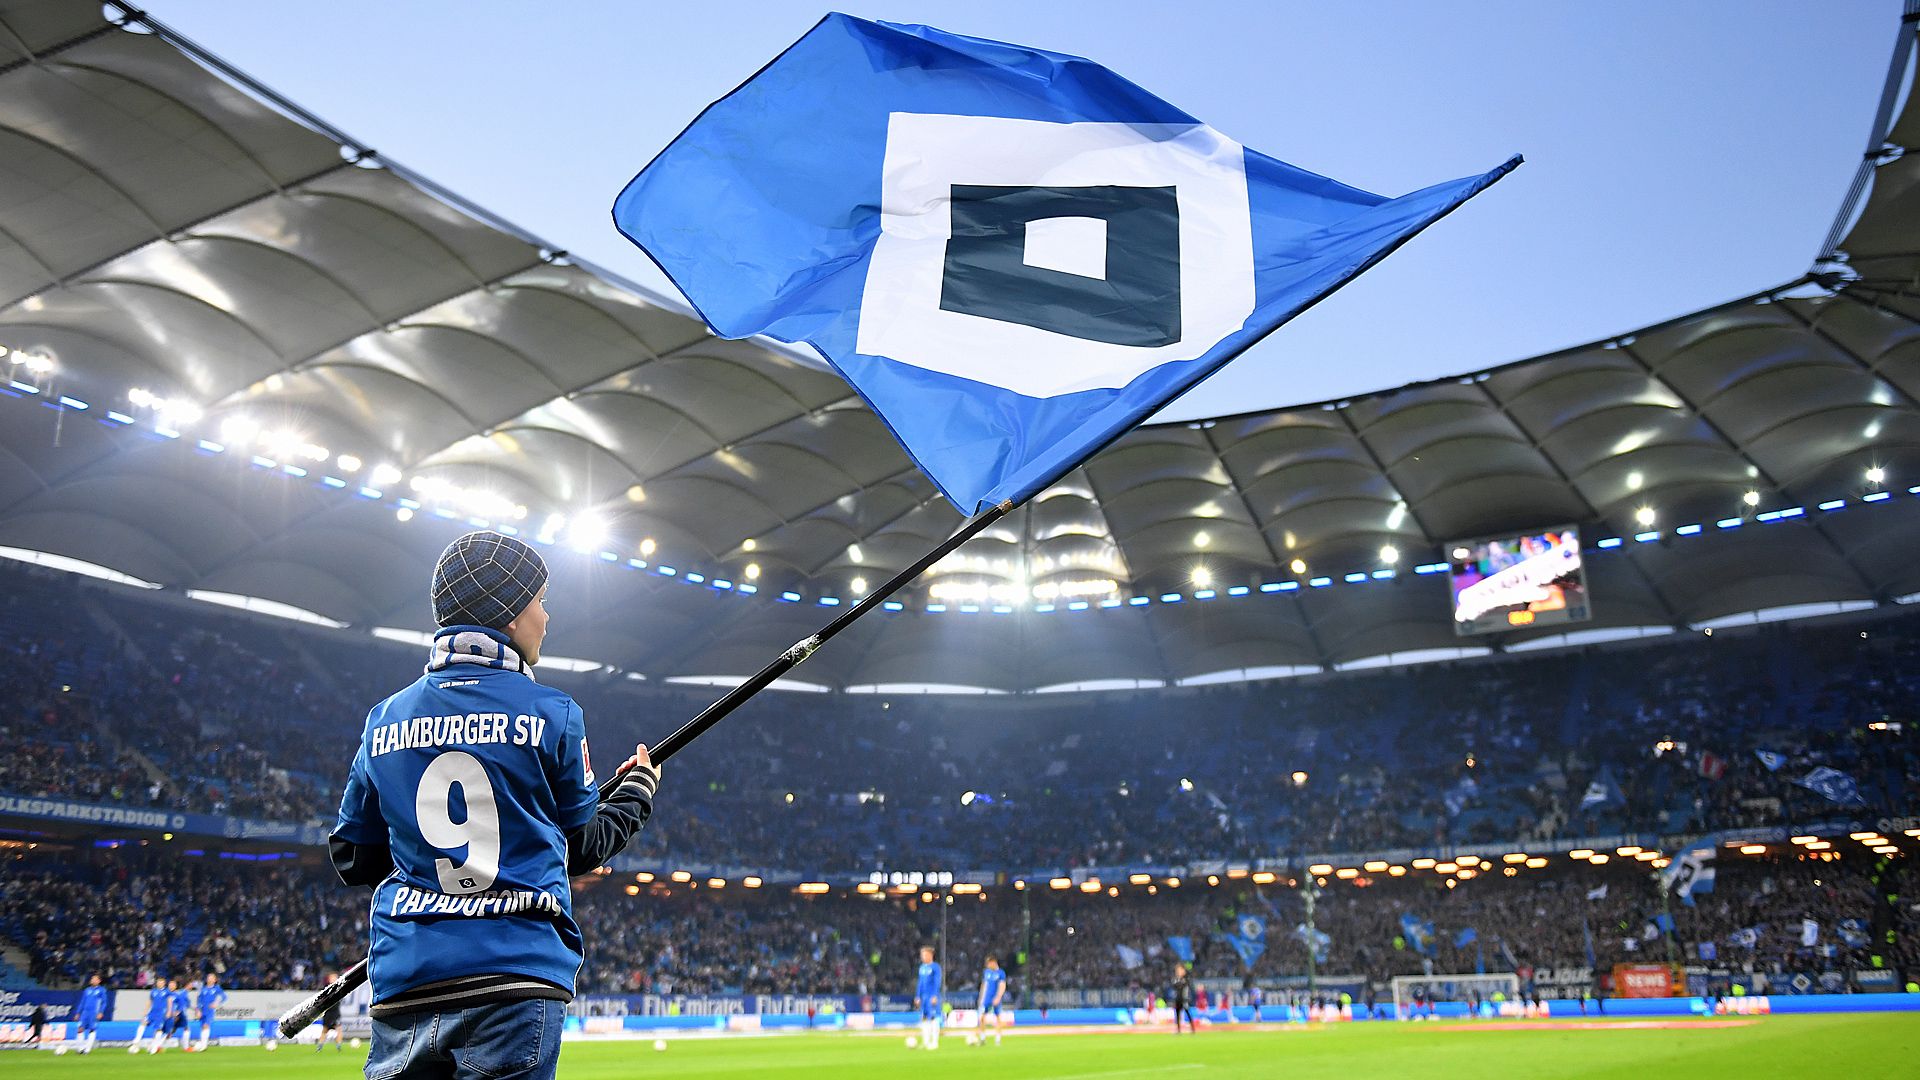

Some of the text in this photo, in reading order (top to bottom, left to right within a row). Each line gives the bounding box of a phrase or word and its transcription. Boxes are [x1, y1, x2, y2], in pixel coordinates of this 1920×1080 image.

[371, 713, 545, 757] HAMBURGER SV
[416, 751, 500, 895] 9
